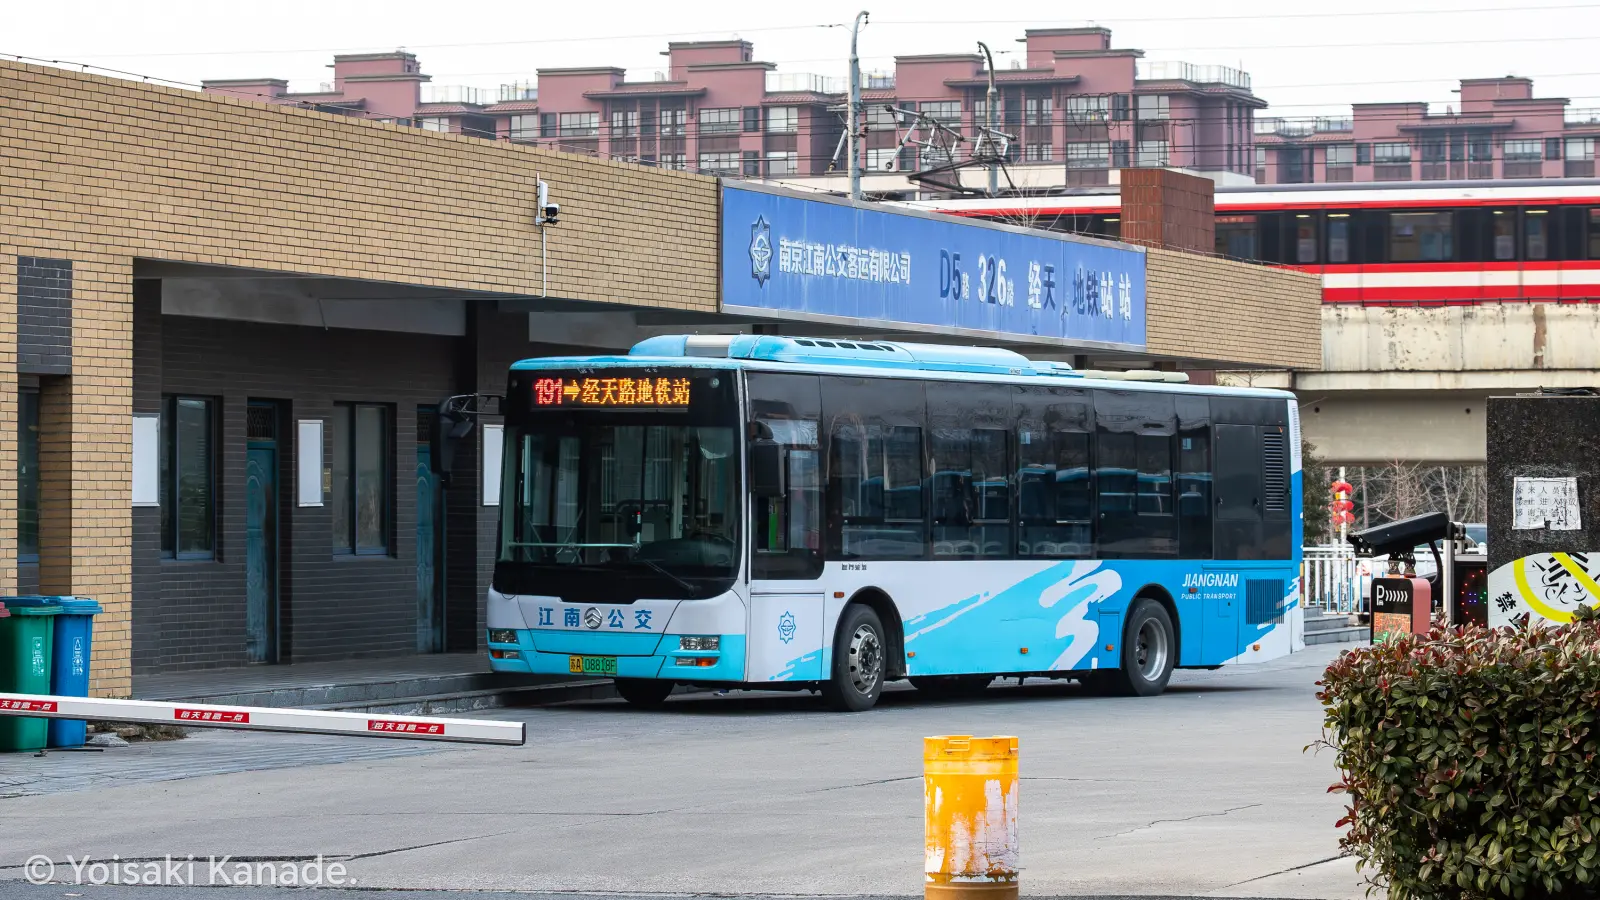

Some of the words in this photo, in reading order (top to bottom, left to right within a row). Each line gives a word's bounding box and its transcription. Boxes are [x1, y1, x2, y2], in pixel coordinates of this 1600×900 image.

[779, 238, 911, 285] 南京江南公交客运有限公司
[534, 377, 563, 405] 191
[582, 377, 690, 405] 经天路地铁站
[1182, 573, 1239, 587] JIANGNAN
[538, 606, 580, 628] 江南
[608, 608, 652, 630] 公交
